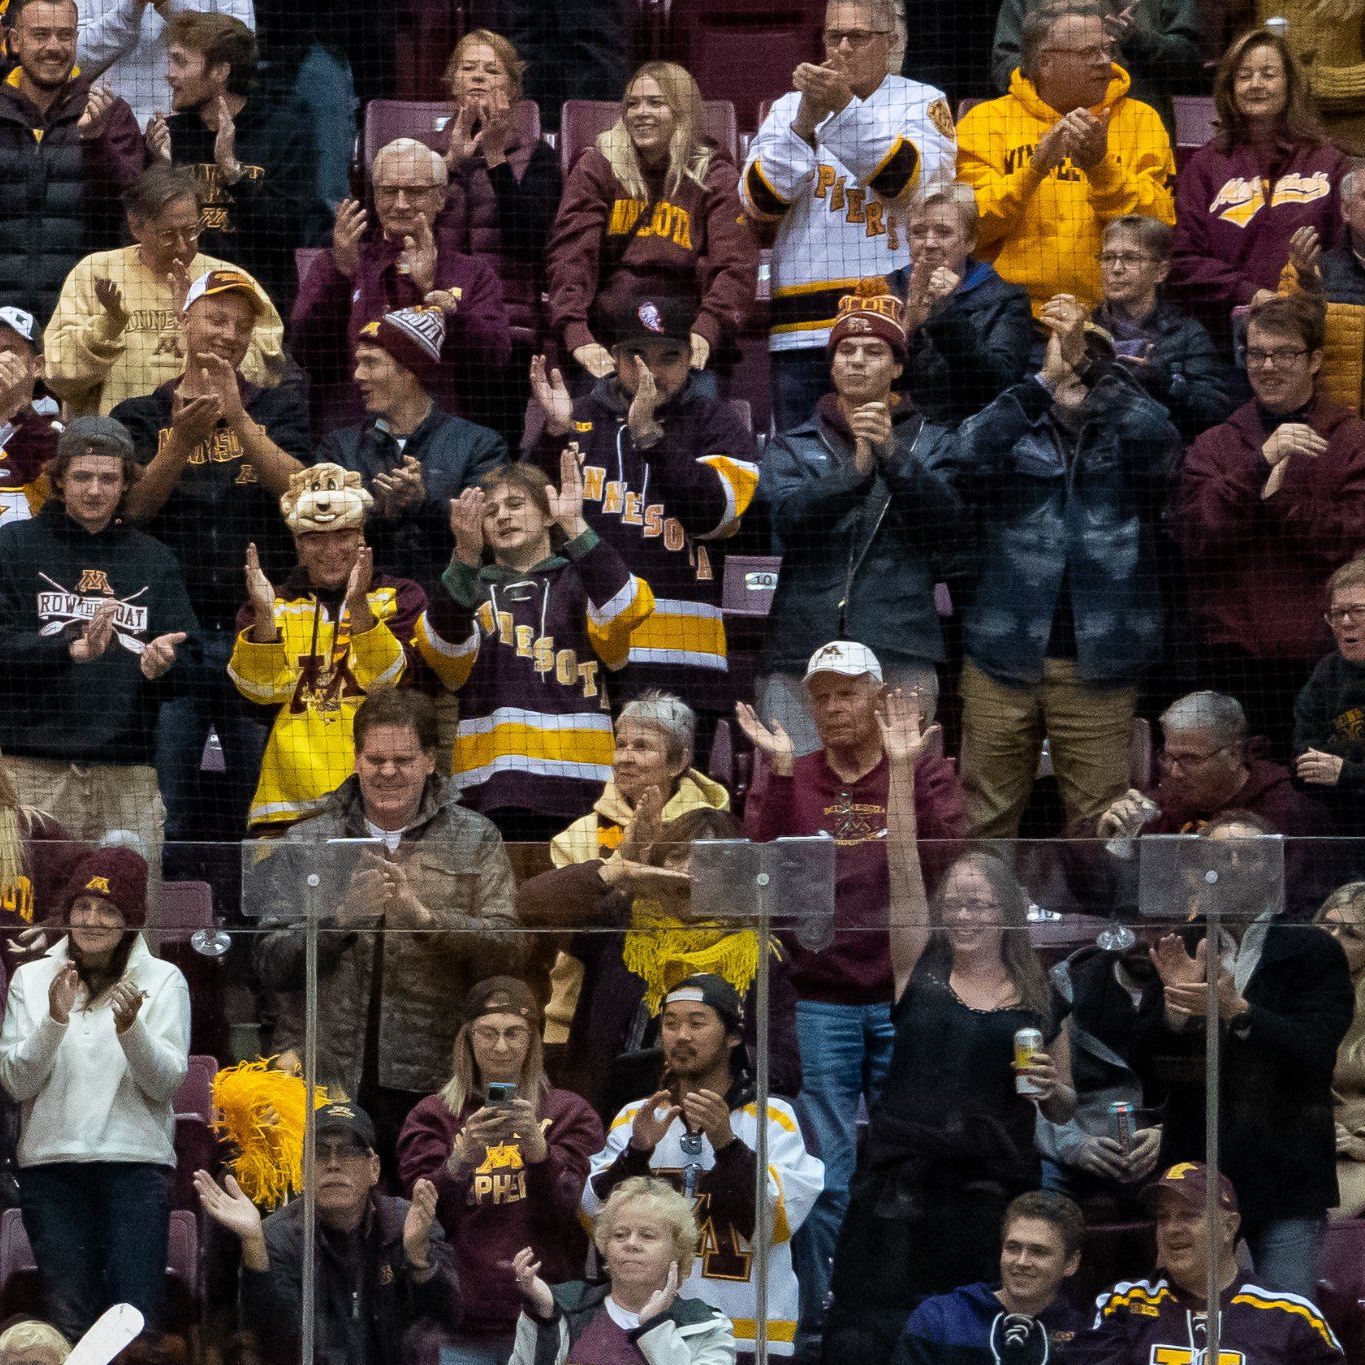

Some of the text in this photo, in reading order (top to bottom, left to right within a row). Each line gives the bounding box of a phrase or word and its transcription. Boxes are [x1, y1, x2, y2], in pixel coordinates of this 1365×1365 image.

[581, 465, 713, 580] NNESOA
[78, 569, 113, 595] M
[756, 575, 772, 587] 10
[40, 593, 77, 615] ROW
[114, 602, 144, 629] OAT
